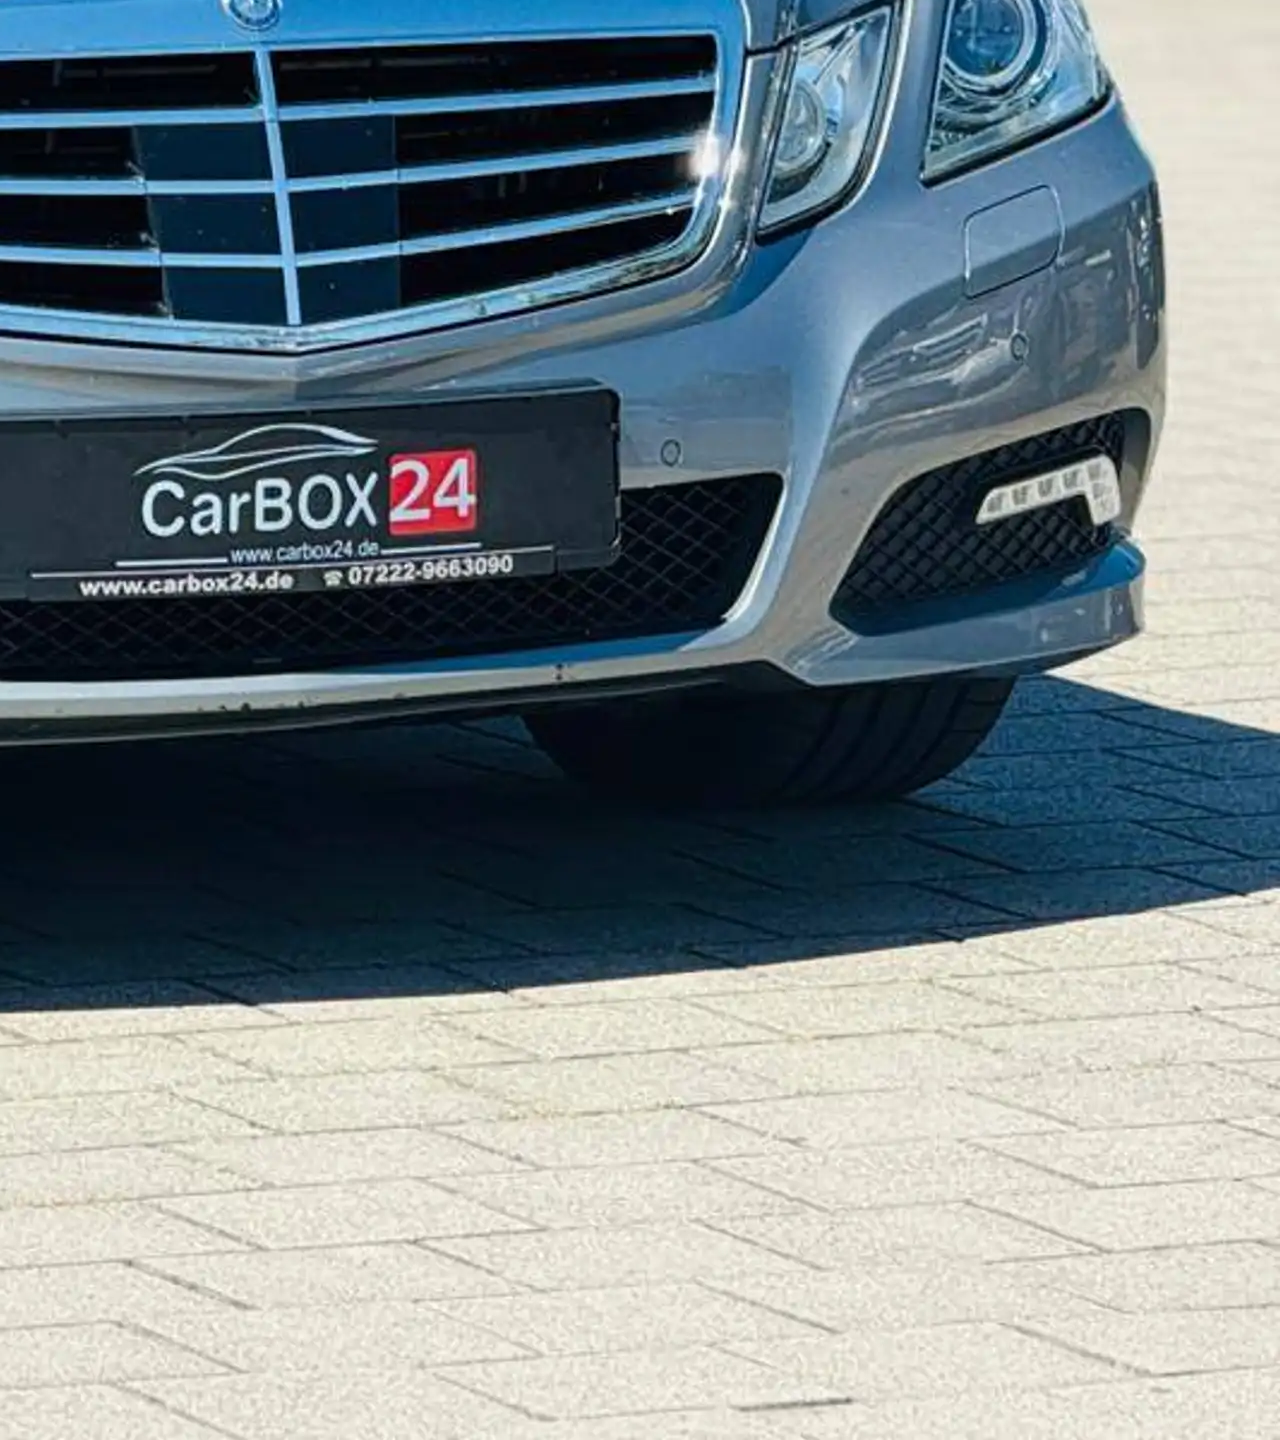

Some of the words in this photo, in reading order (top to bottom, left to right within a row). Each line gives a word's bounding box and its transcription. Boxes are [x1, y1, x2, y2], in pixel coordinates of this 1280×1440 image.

[230, 542, 379, 564] www.carbox24.de
[79, 572, 294, 596] www.carbox24.de
[348, 555, 514, 585] 07222-9663090
